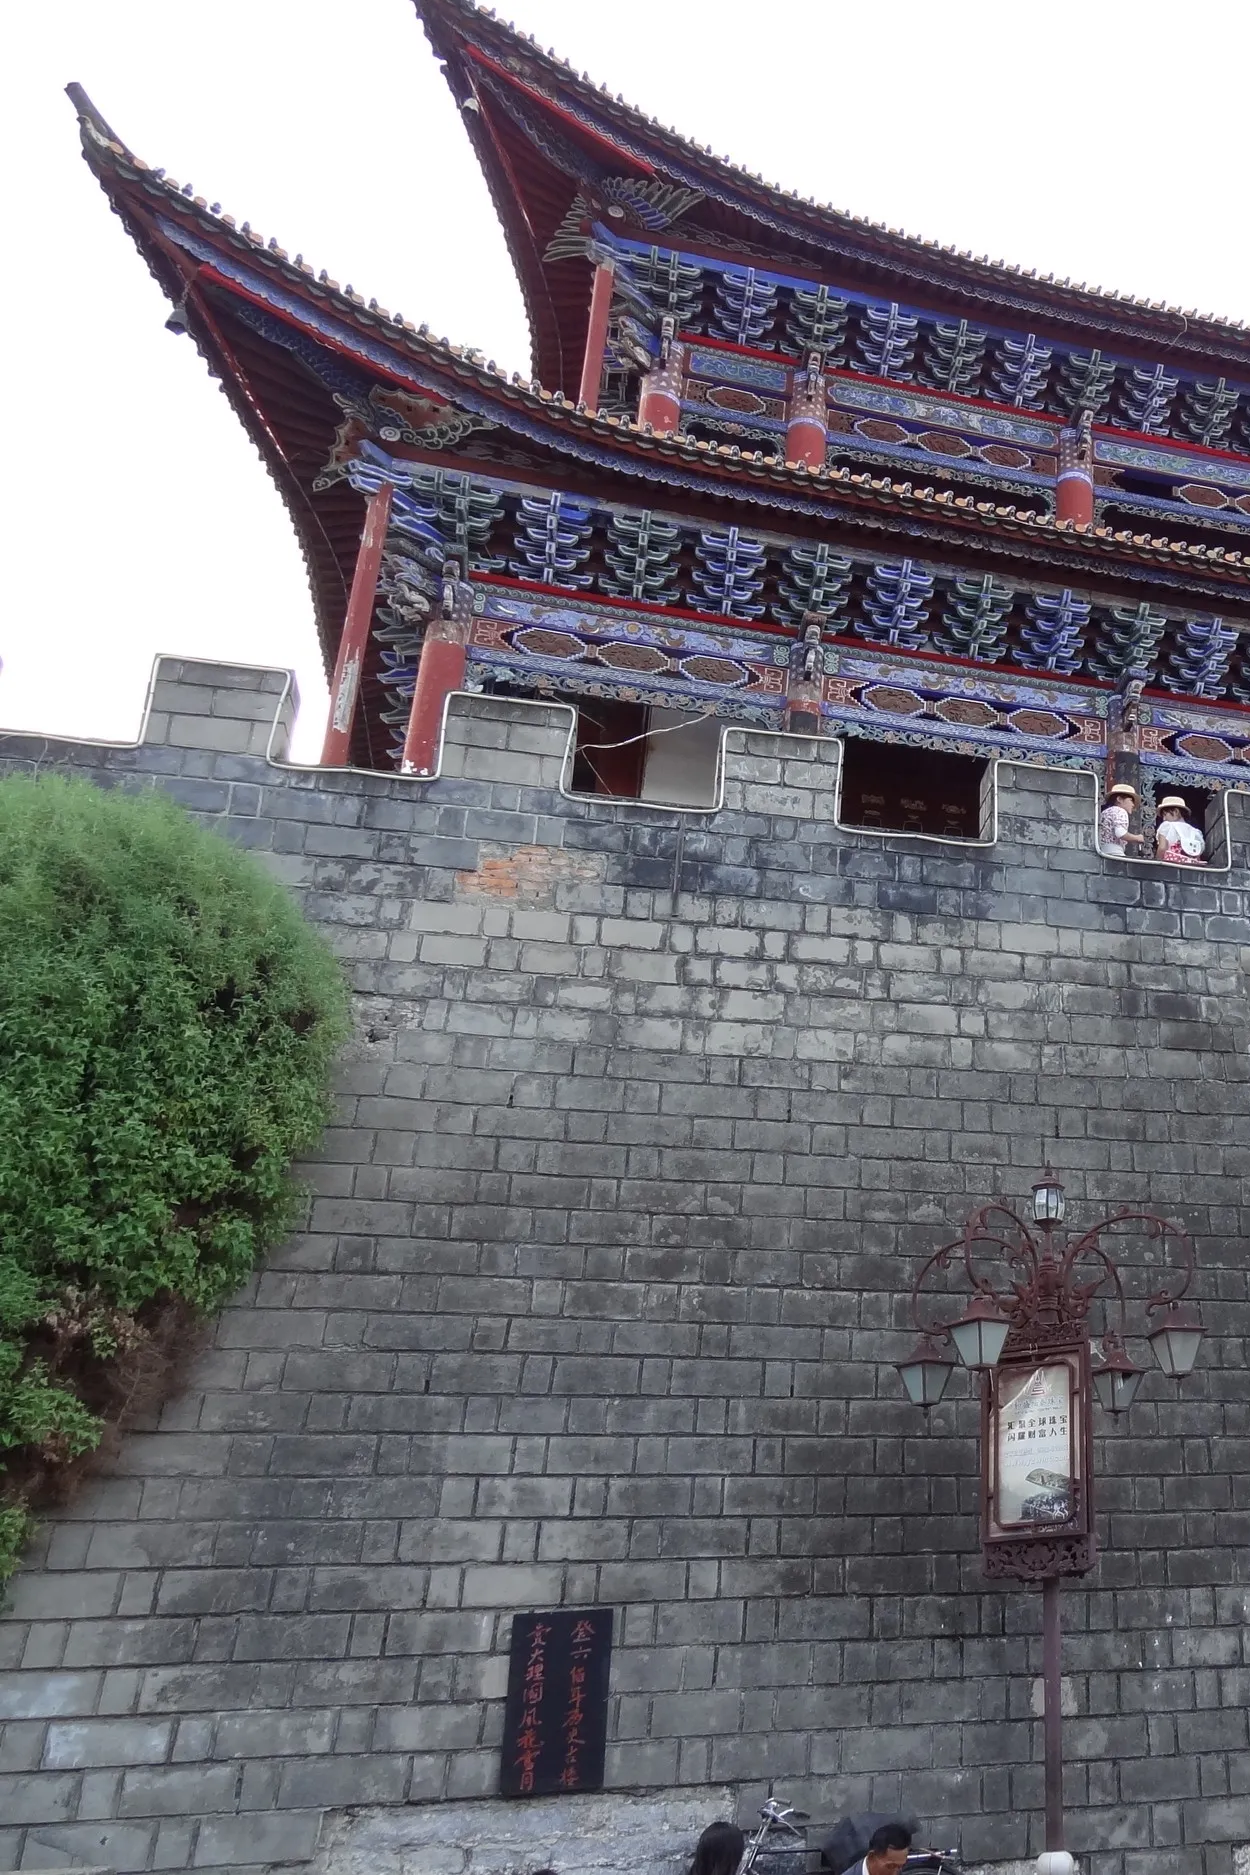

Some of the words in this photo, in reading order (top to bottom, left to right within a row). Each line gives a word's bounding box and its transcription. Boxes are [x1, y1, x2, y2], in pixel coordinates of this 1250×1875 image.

[1007, 1427, 1067, 1441] 闪耀财富人生
